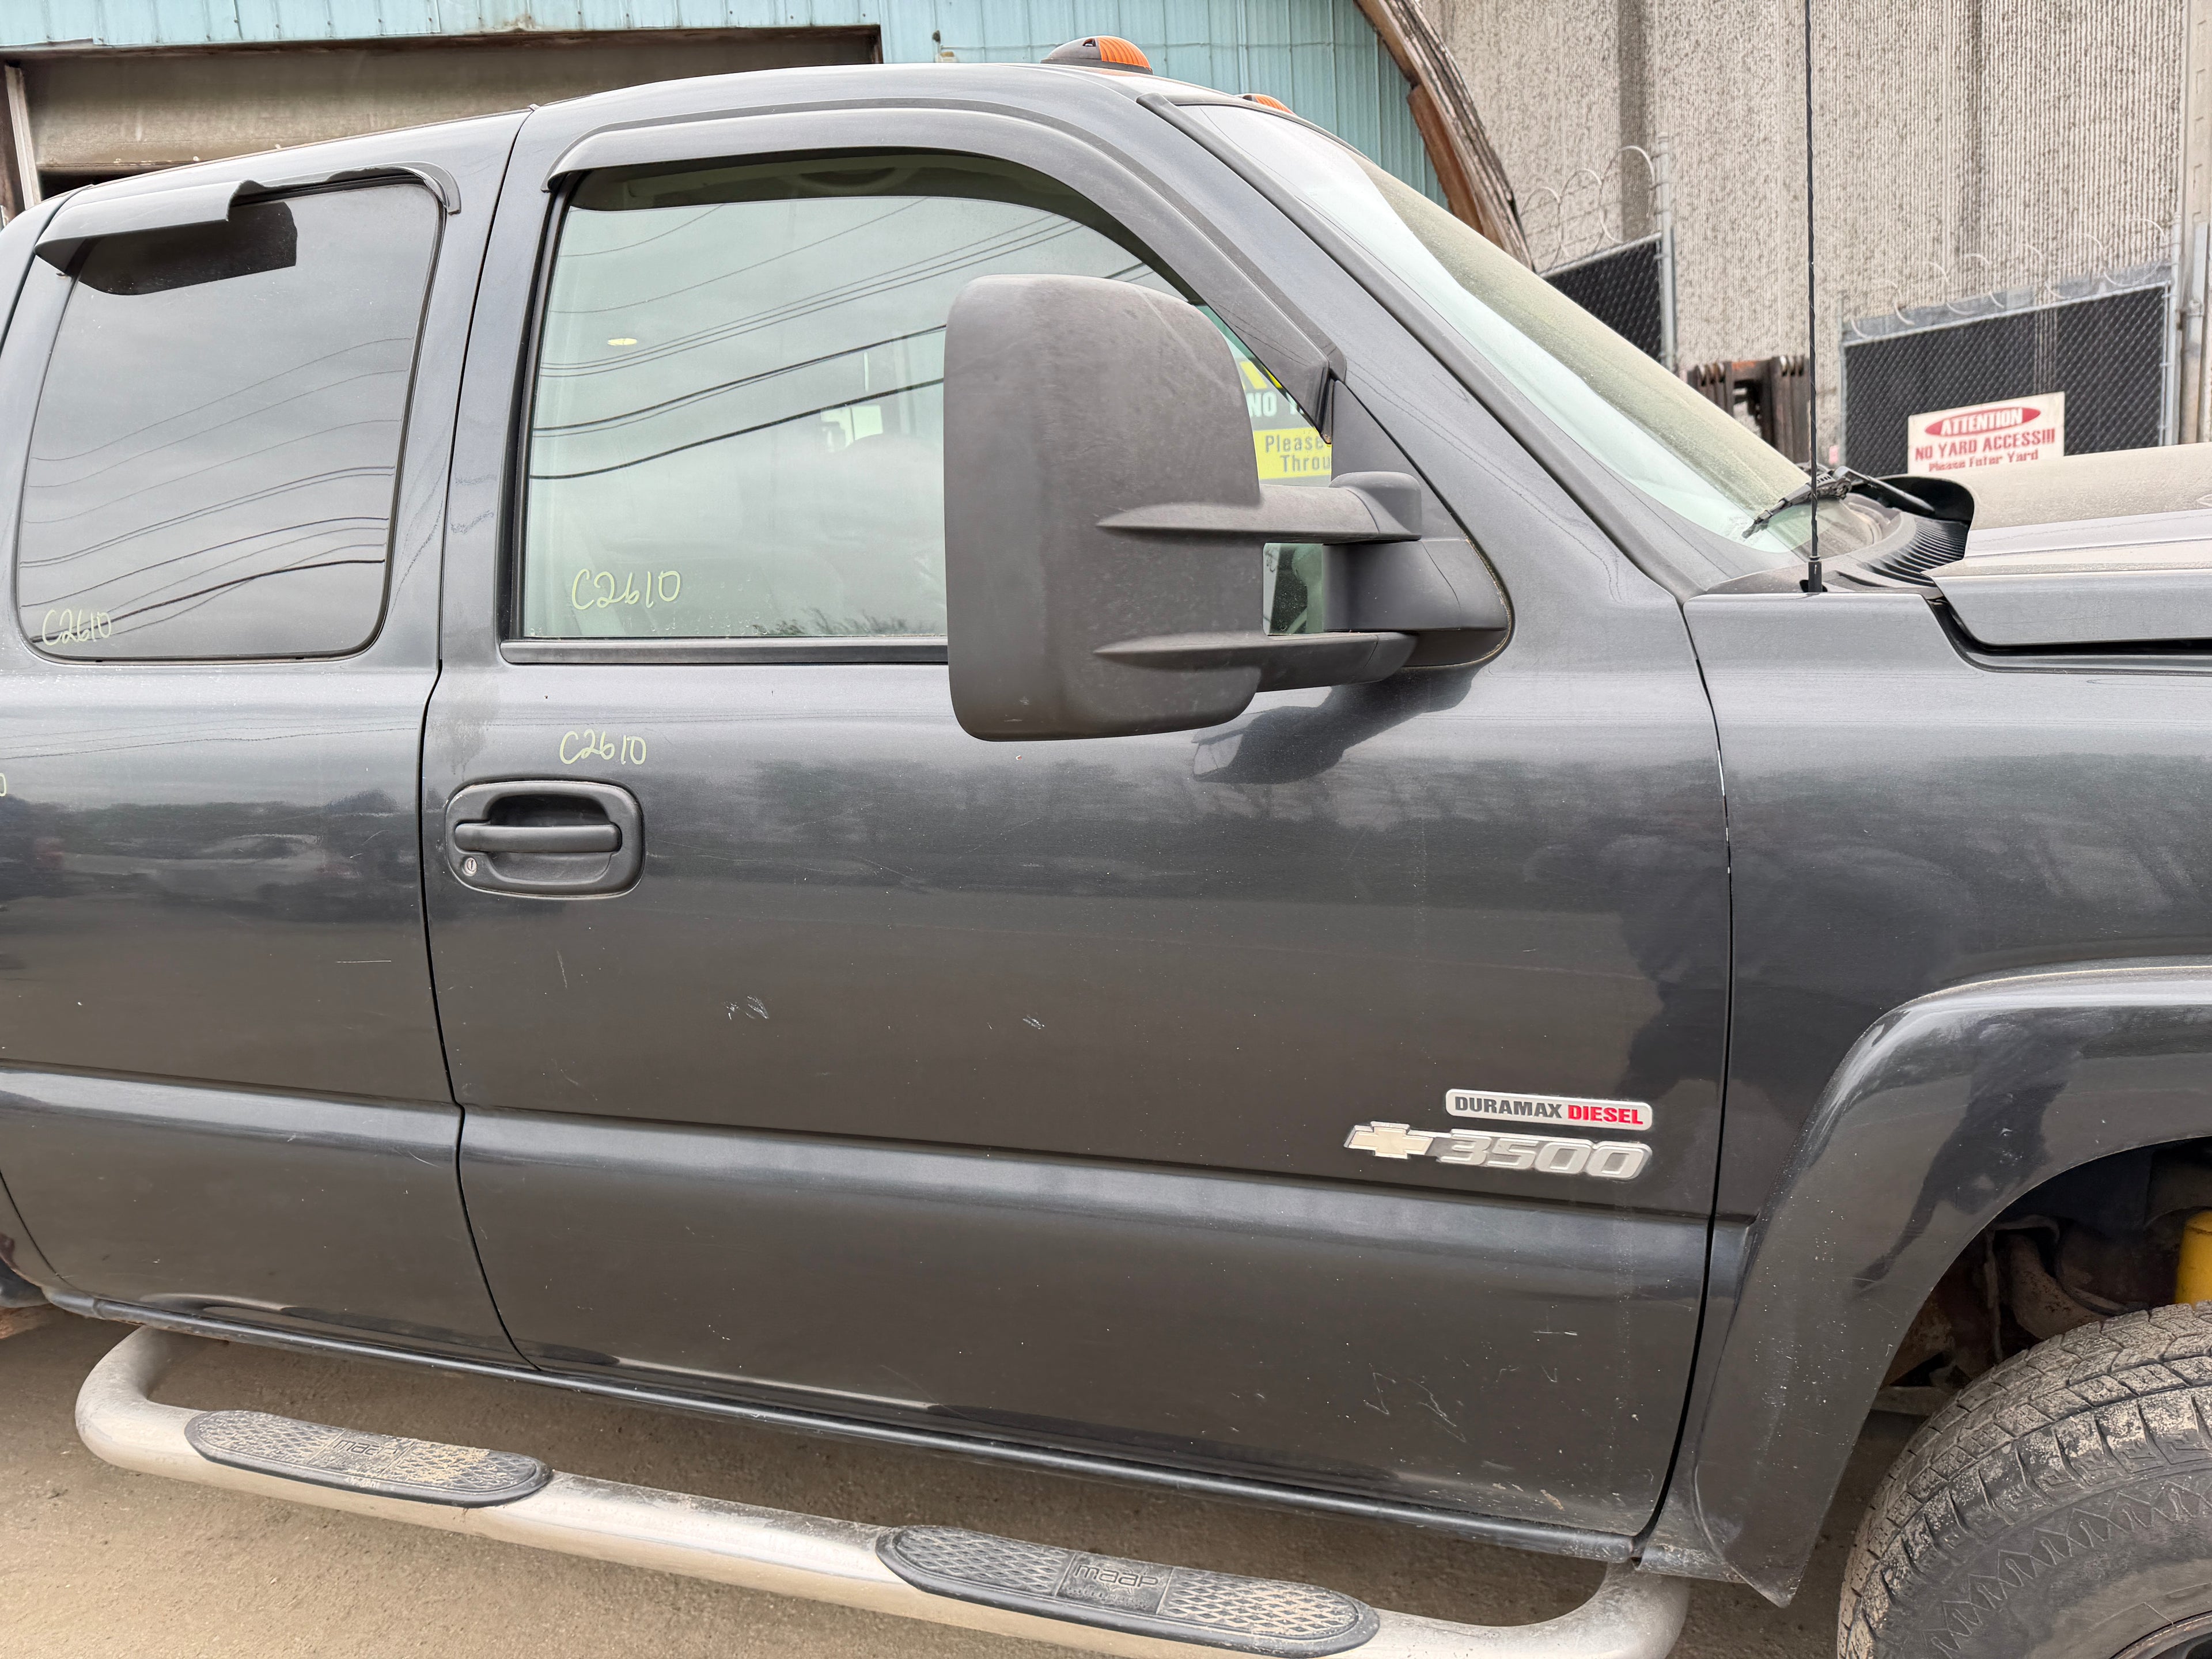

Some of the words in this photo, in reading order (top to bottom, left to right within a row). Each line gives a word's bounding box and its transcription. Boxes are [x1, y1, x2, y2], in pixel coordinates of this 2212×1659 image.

[1246, 392, 1278, 418] NO
[1940, 408, 2023, 437] ATTENTION
[1266, 434, 1324, 453] Please
[1915, 446, 1933, 460] NO
[1938, 438, 1978, 458] YARD
[1983, 428, 2055, 452] ACCESS!!!
[2008, 448, 2039, 463] Yard
[571, 569, 681, 610] C2610
[42, 609, 112, 646] C2610
[560, 729, 647, 765] C2610
[1455, 1096, 1562, 1119] DURAMAX
[1568, 1104, 1644, 1126] DIESEL
[1440, 1129, 1652, 1180] 3500
[1074, 1564, 1158, 1588] maap
